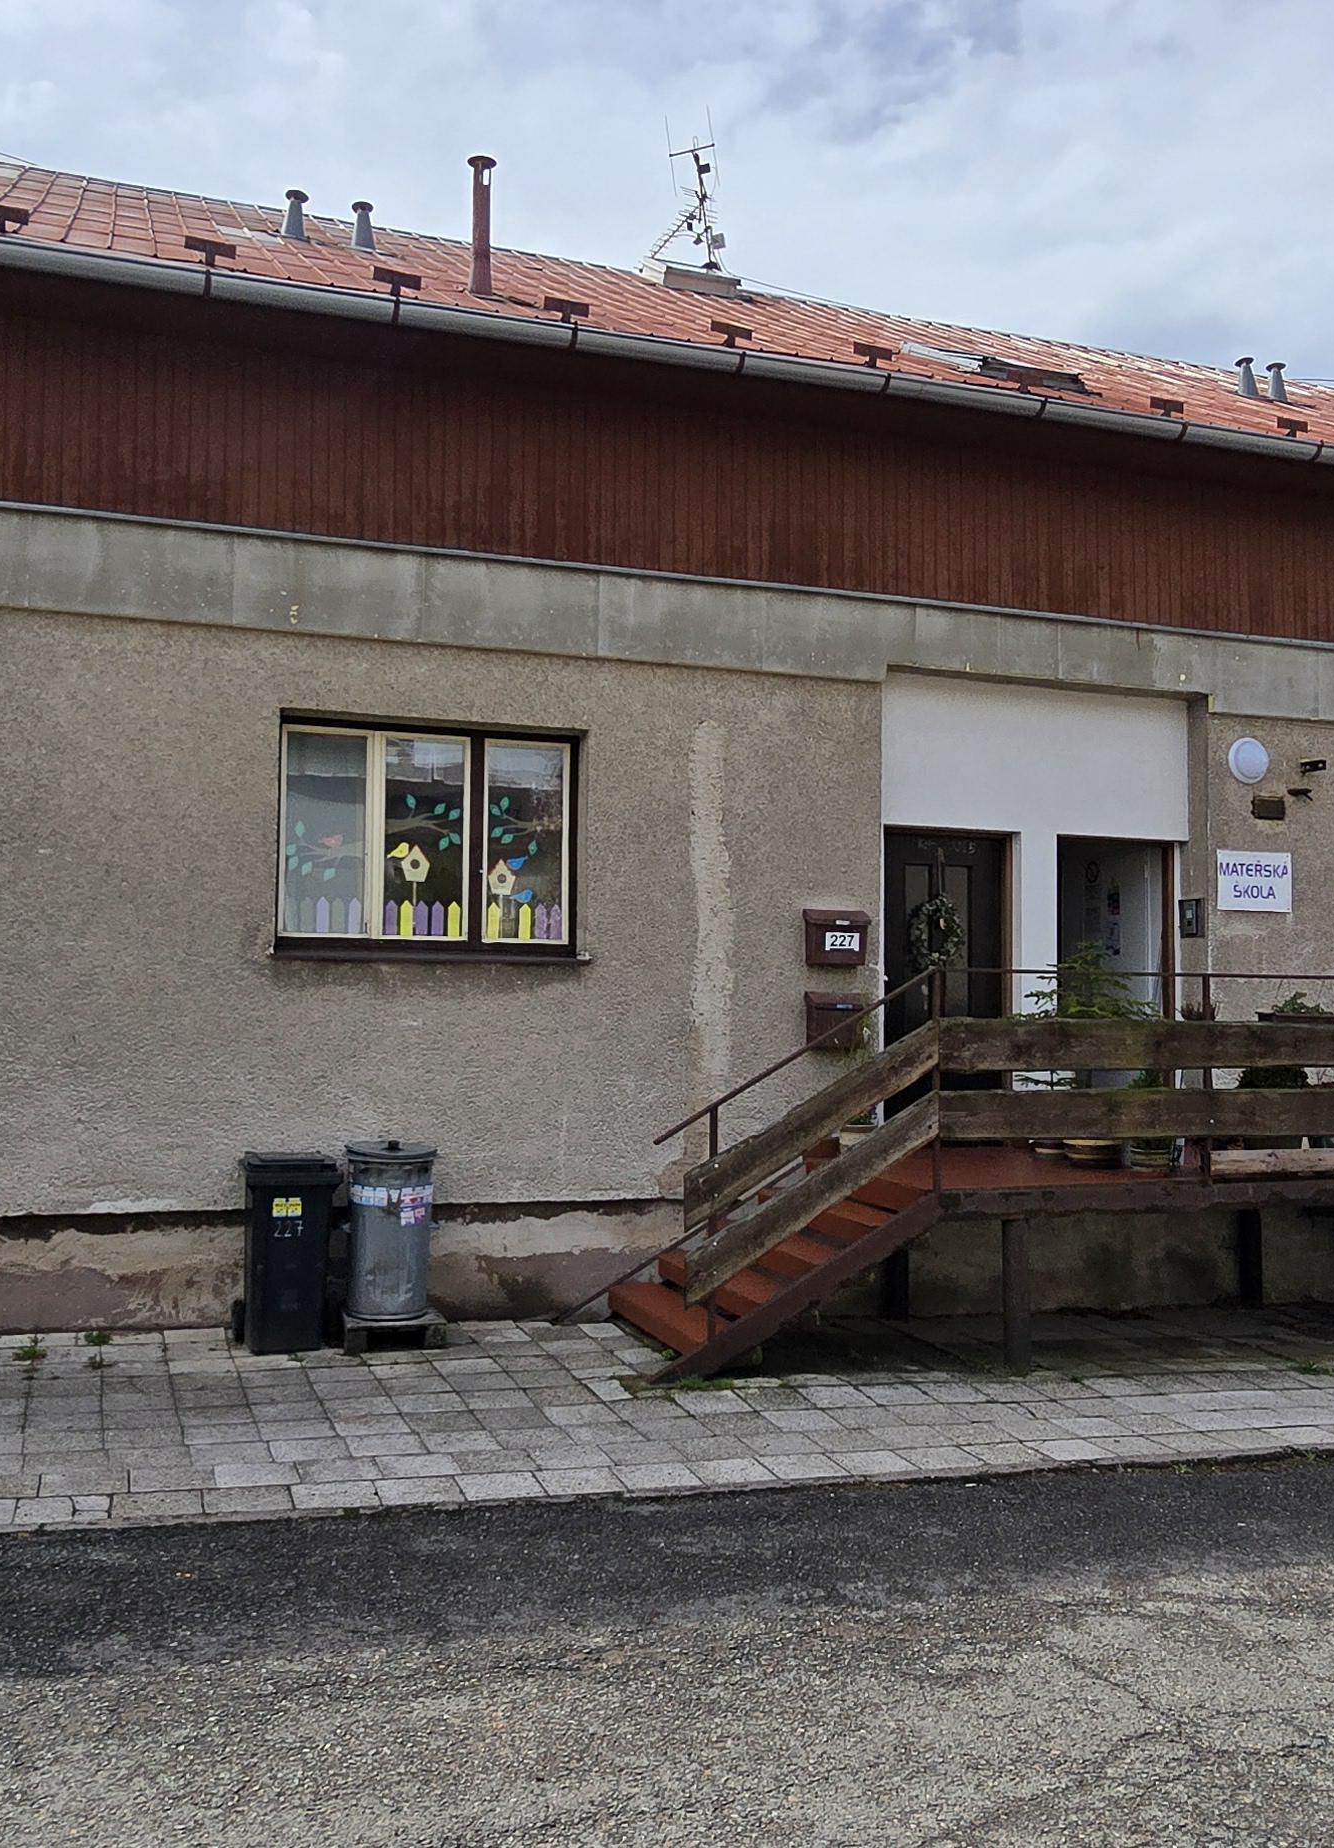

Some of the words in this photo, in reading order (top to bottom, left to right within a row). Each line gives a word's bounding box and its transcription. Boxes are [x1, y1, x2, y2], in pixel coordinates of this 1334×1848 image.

[1219, 861, 1288, 878] MATEŘSKÁ
[1233, 880, 1276, 898] ŠKOLA
[830, 934, 855, 947] 227
[274, 1220, 304, 1237] 227
